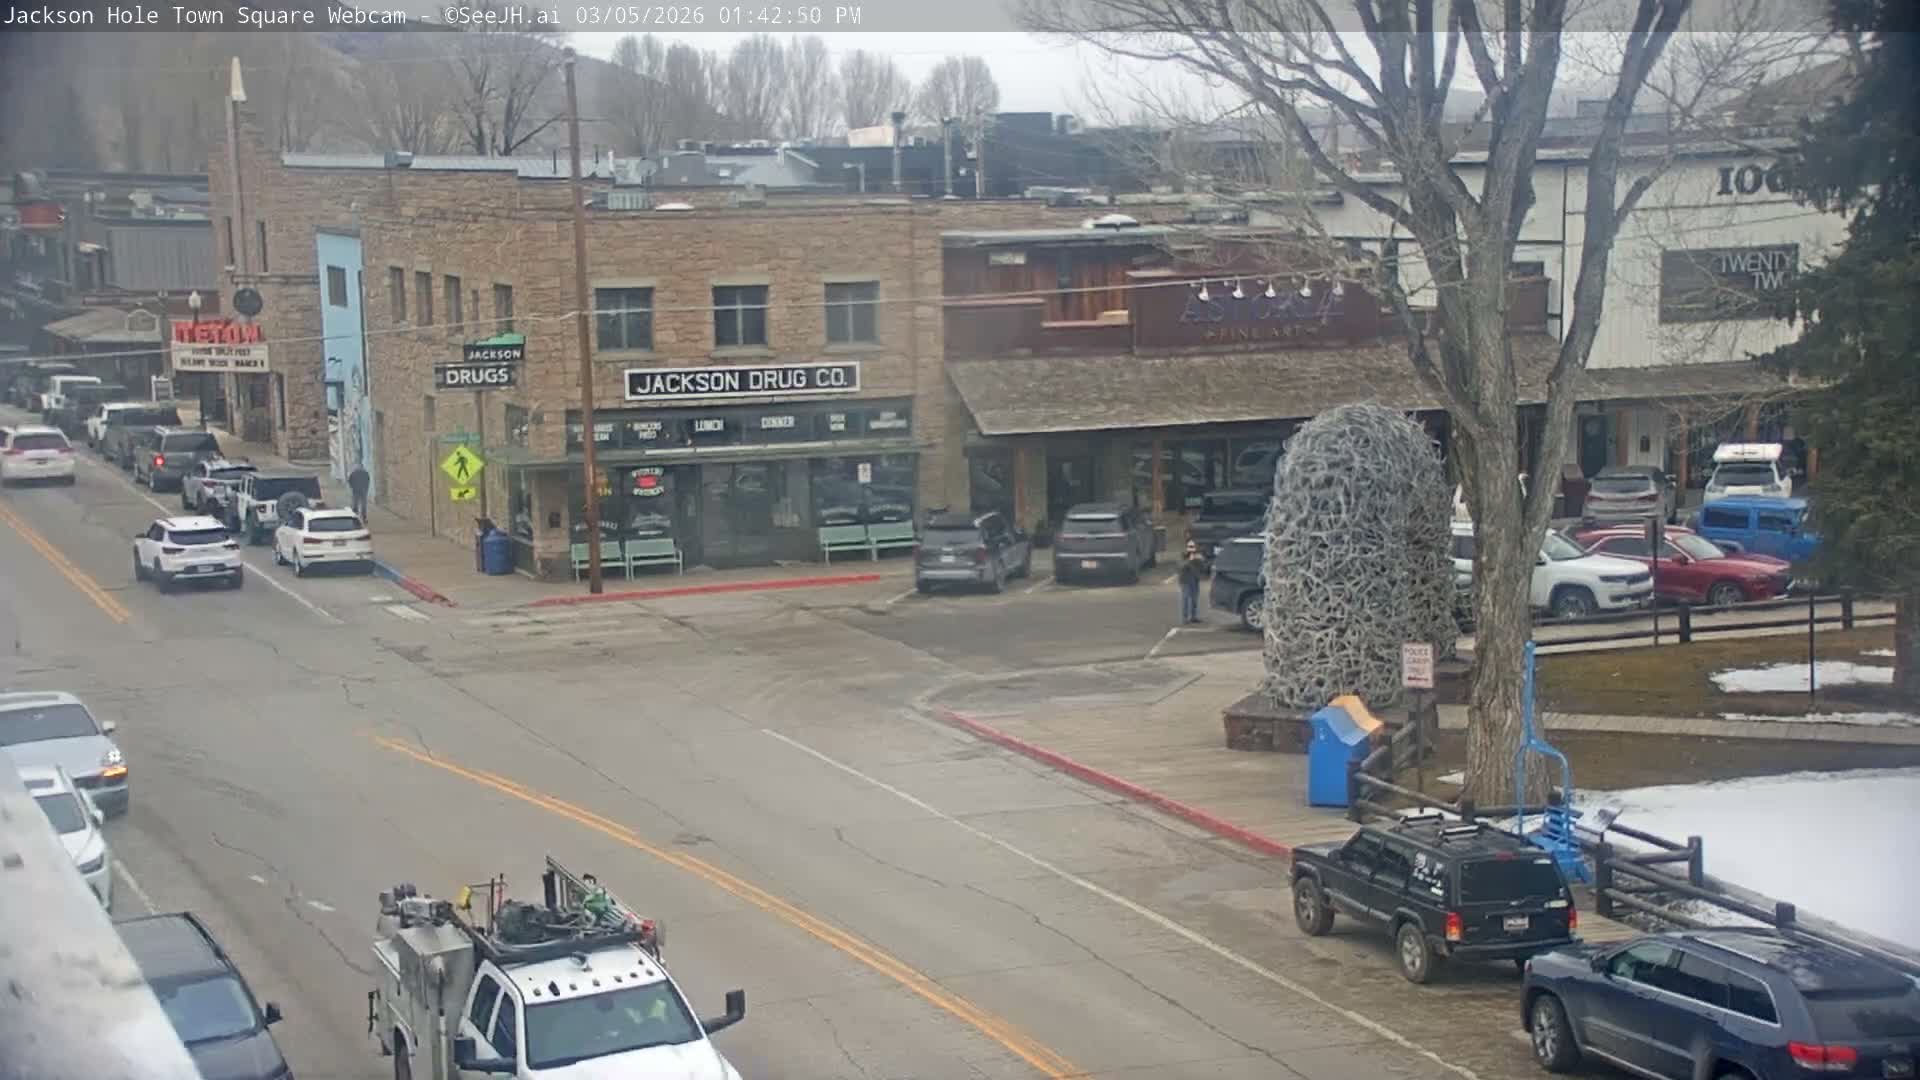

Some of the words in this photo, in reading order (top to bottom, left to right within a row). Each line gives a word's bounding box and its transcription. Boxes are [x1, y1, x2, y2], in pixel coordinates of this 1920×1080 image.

[467, 348, 522, 361] JACKSON
[446, 366, 509, 385] DRUGS
[636, 371, 740, 395] JACKSON
[749, 369, 808, 390] DRUG
[815, 367, 849, 387] CO.
